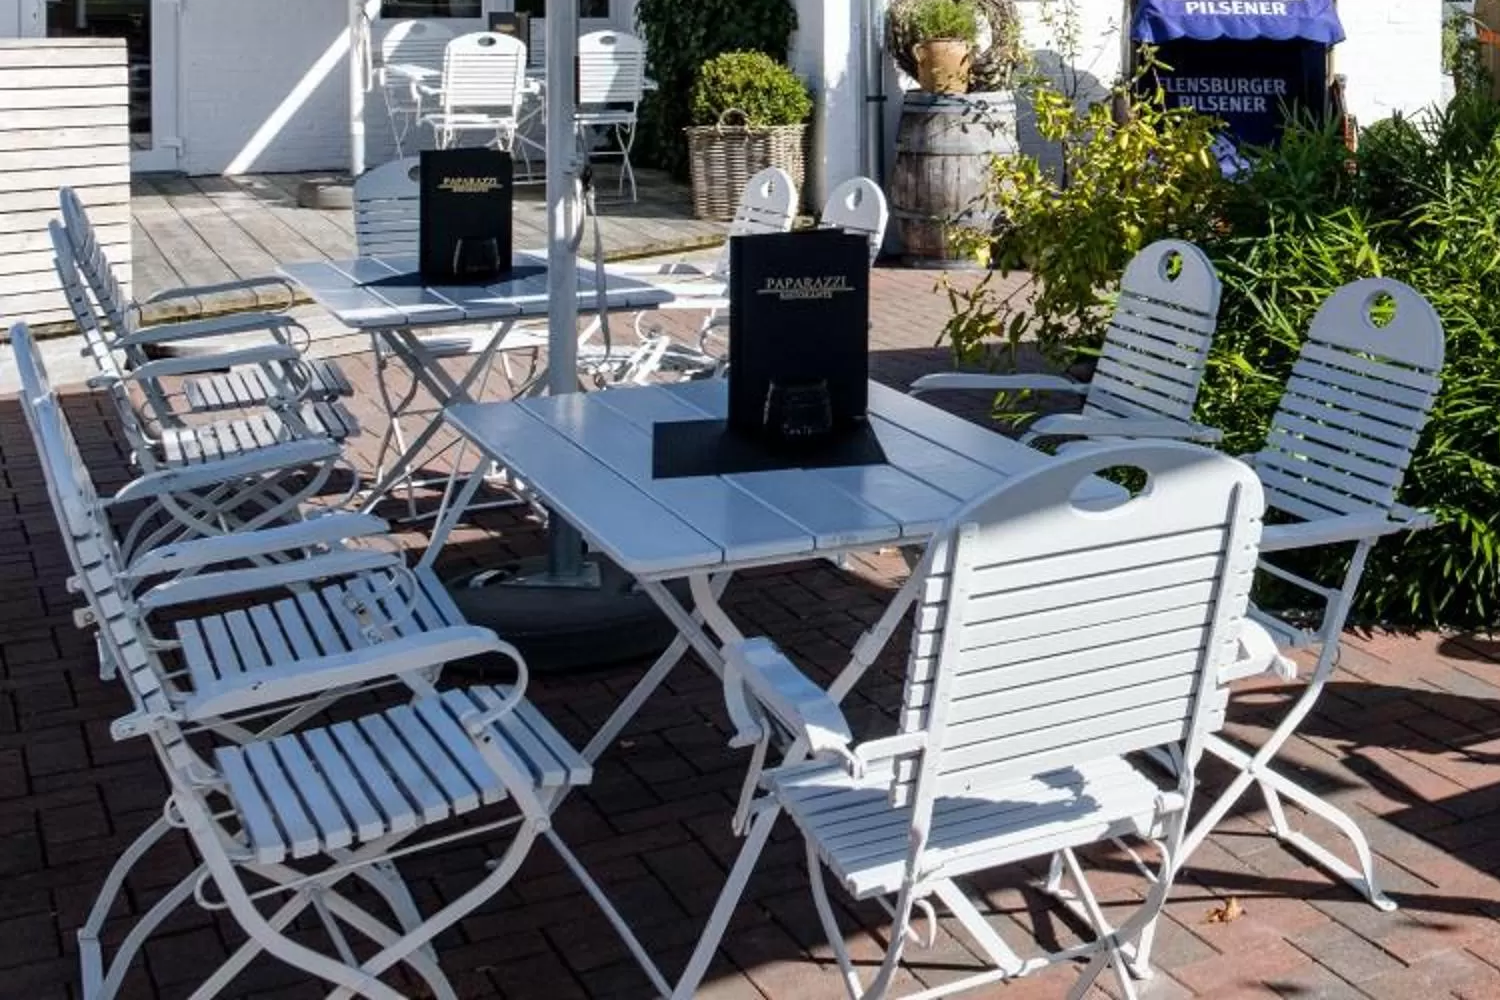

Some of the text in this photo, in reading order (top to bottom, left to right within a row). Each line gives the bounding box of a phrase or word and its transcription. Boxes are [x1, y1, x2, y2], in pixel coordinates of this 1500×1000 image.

[1185, 1, 1288, 17] PILSENER
[1178, 95, 1268, 113] PILSENER
[766, 275, 848, 290] PAPARAZZI
